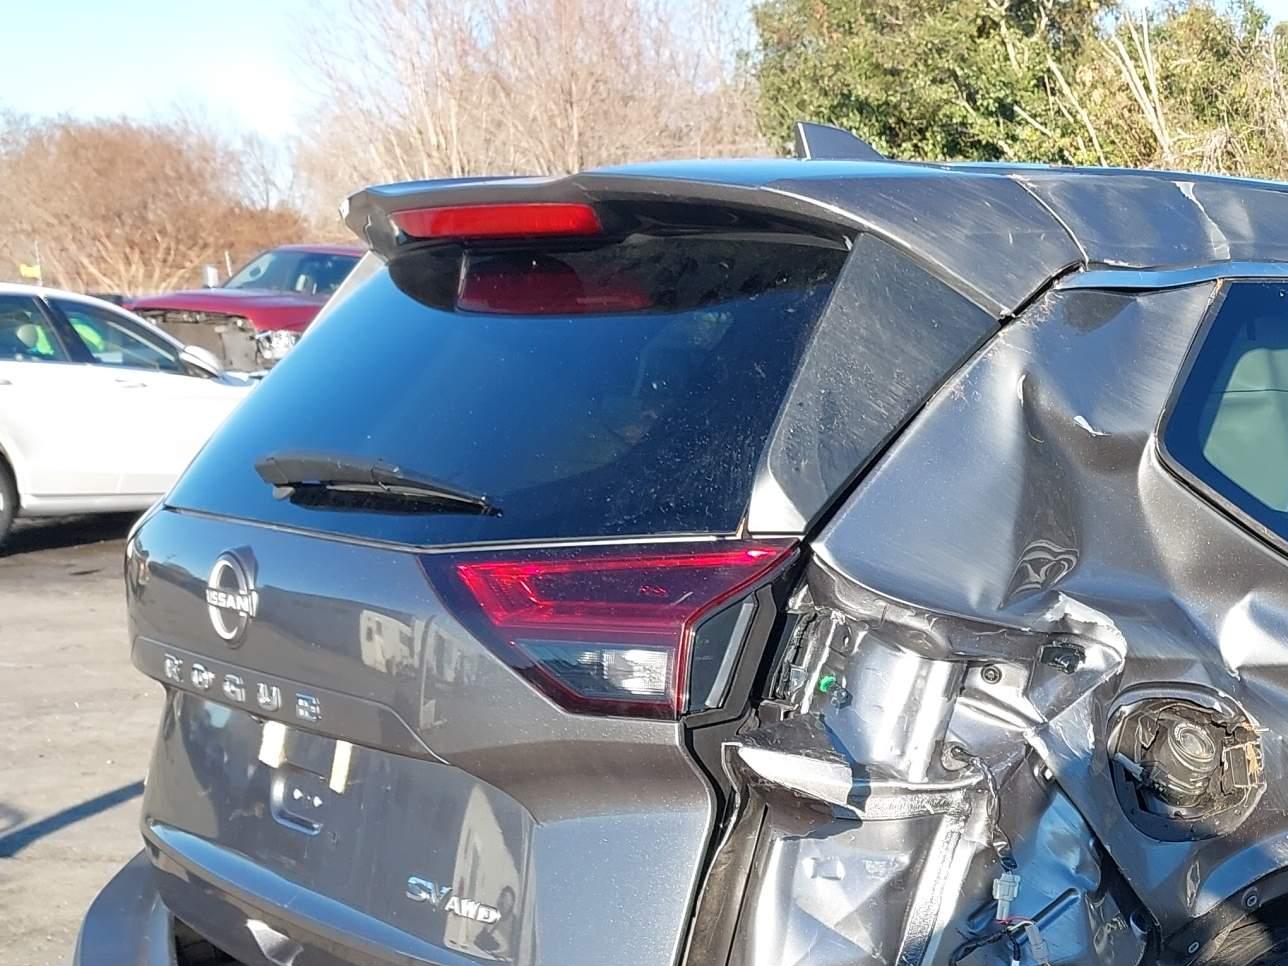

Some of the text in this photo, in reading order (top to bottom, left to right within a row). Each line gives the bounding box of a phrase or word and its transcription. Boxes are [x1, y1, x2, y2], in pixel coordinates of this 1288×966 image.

[164, 652, 323, 722] ROGUE
[406, 876, 501, 924] SV AWD
